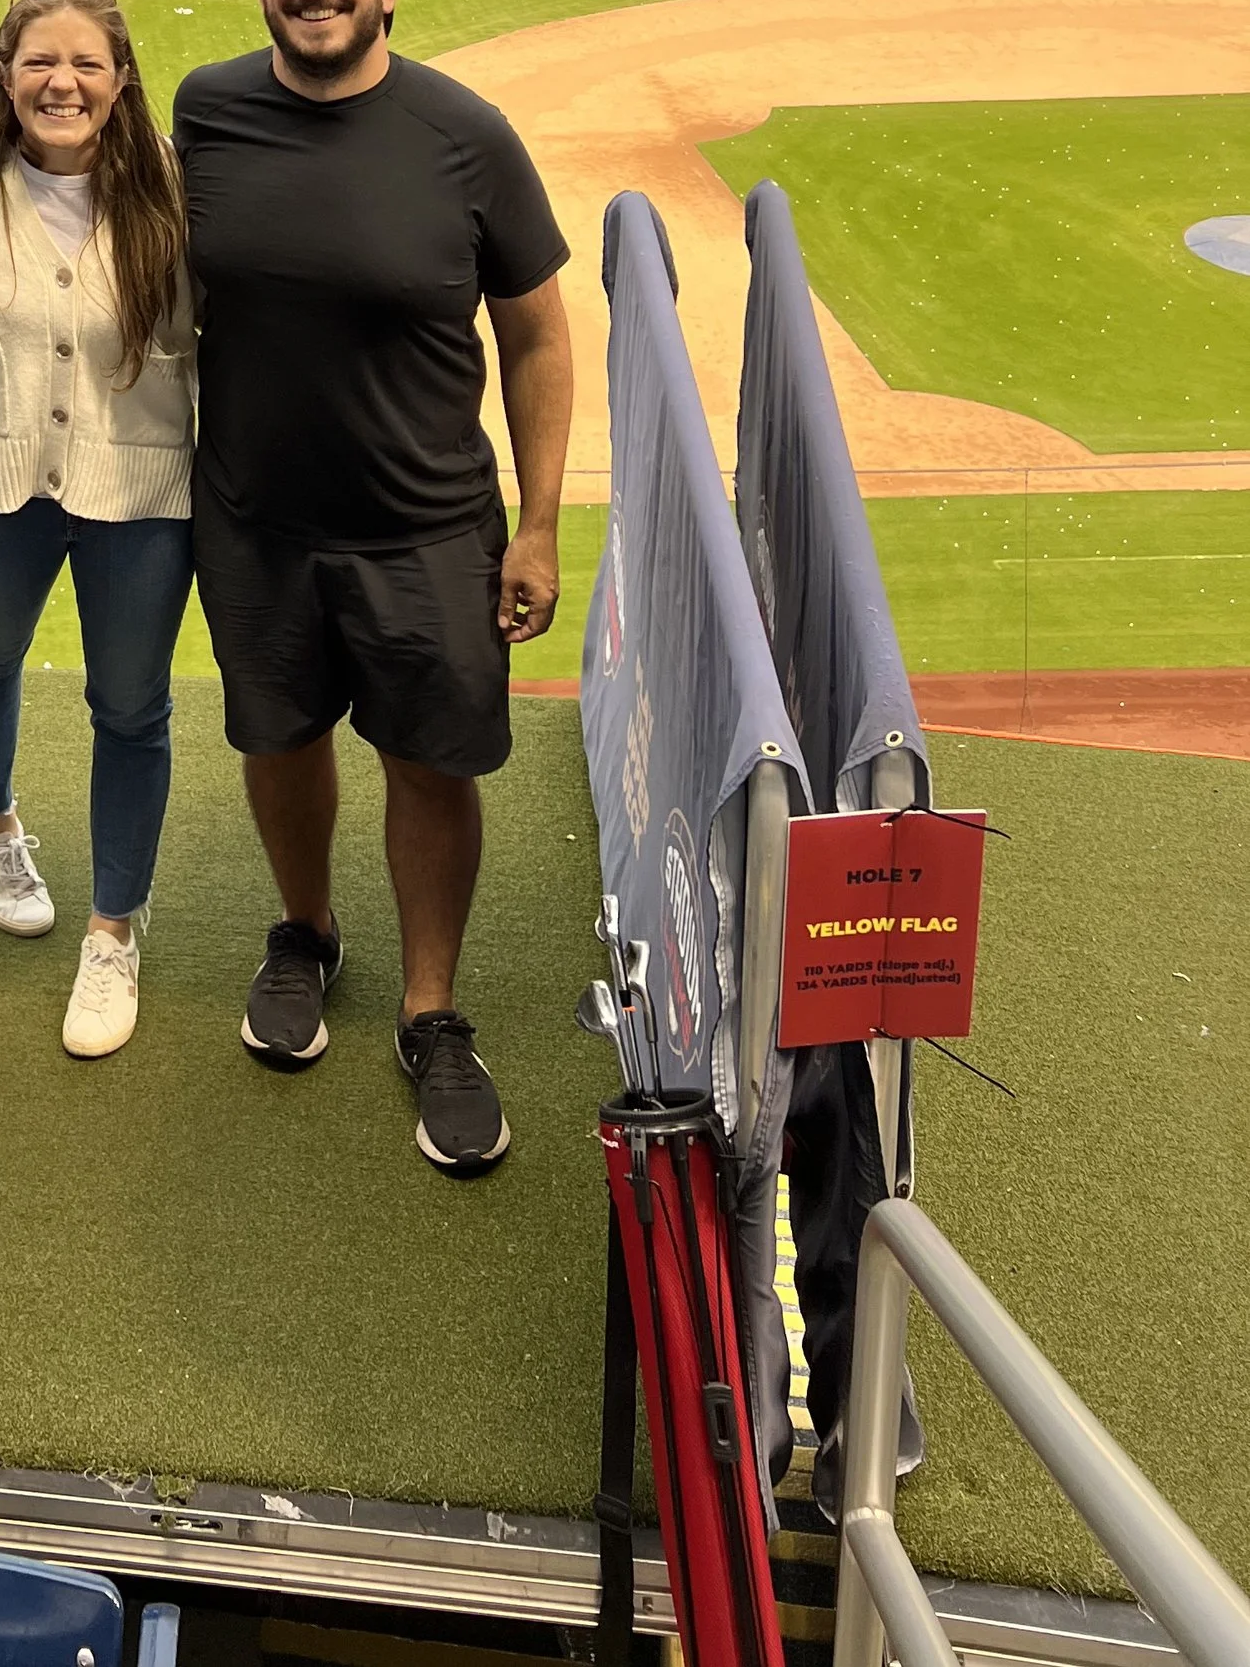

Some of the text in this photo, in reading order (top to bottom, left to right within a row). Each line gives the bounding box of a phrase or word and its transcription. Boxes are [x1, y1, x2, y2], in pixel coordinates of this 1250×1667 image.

[847, 868, 922, 884] HOLE 7
[806, 917, 957, 938] YELLOW FLAG
[828, 960, 872, 974] YARDS
[924, 959, 955, 971] adj.)
[797, 972, 961, 991] 134 YARDS (unadjusted)
